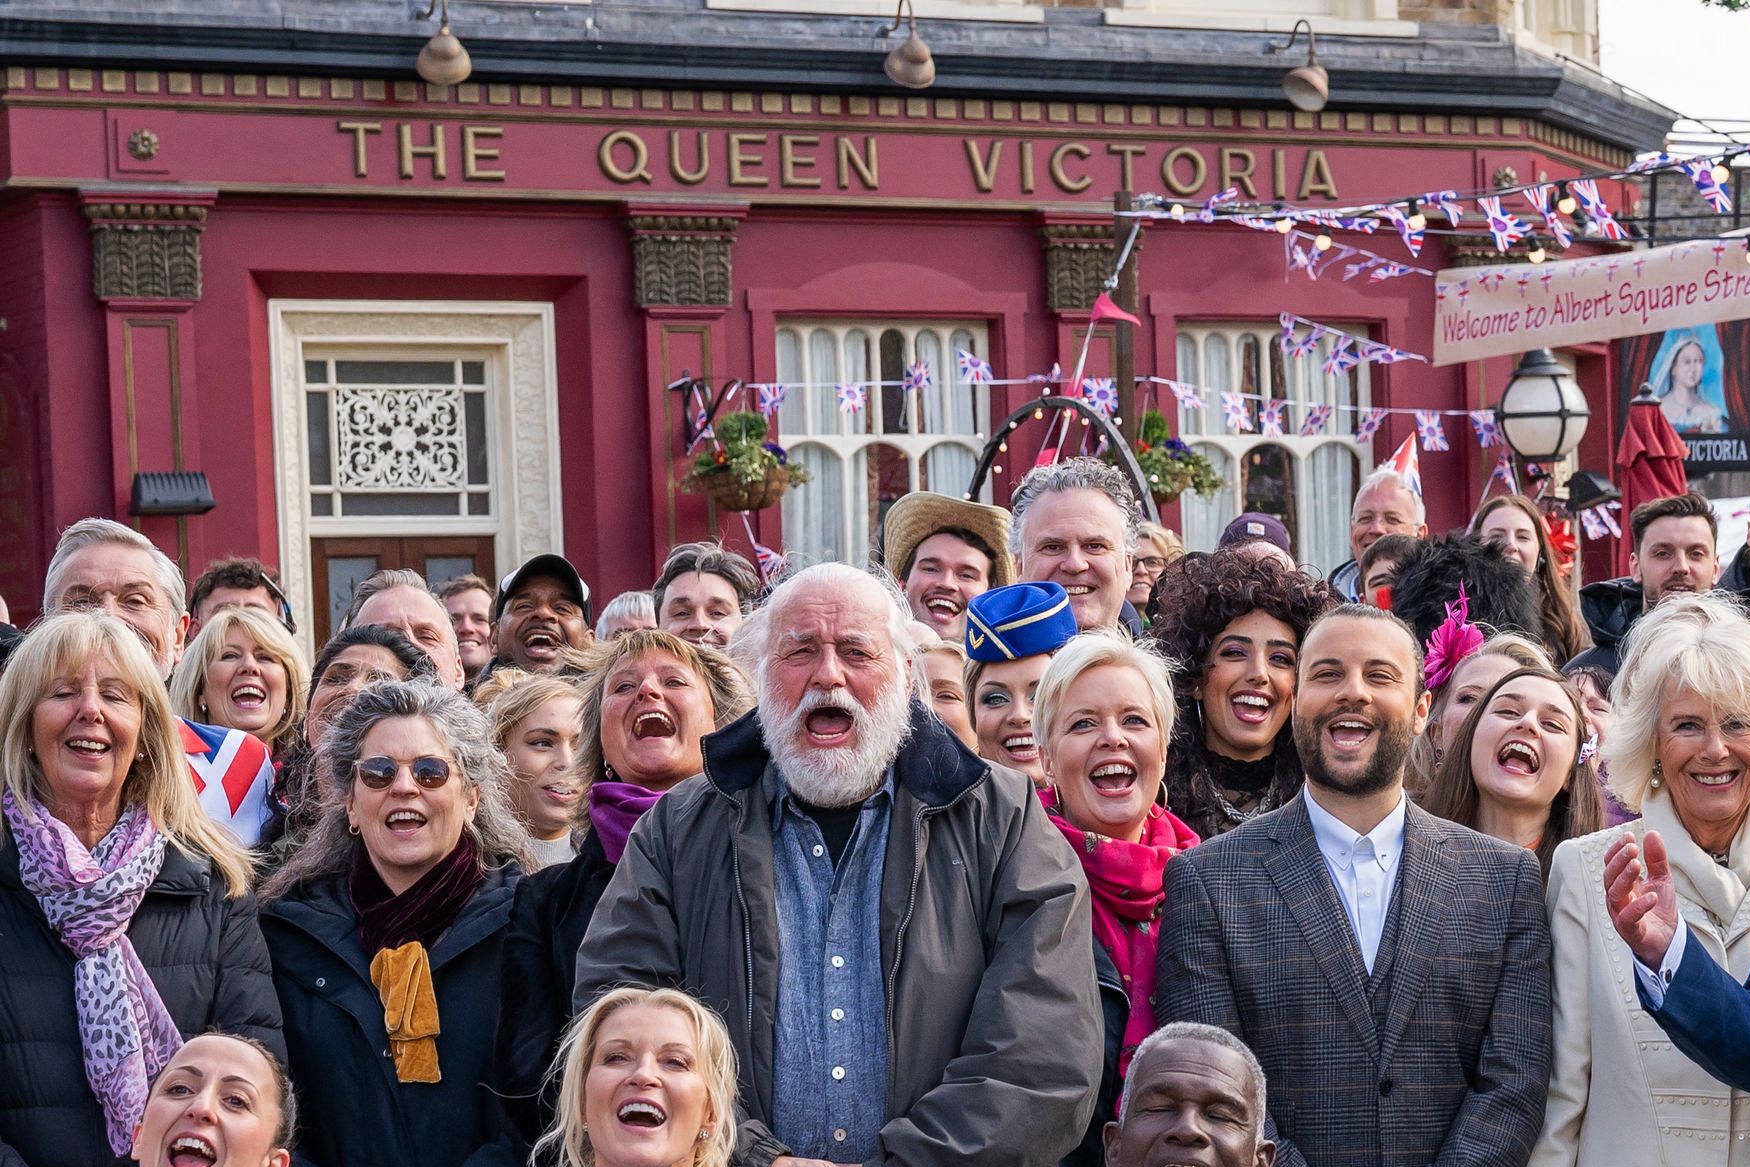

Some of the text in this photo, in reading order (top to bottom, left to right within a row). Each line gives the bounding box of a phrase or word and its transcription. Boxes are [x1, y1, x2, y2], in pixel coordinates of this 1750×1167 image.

[337, 120, 1339, 200] THE QUEEN VICTORIA
[1443, 309, 1520, 344] Welcome
[1525, 304, 1546, 329] to
[1550, 292, 1613, 325] Albert
[1619, 280, 1697, 324] Square
